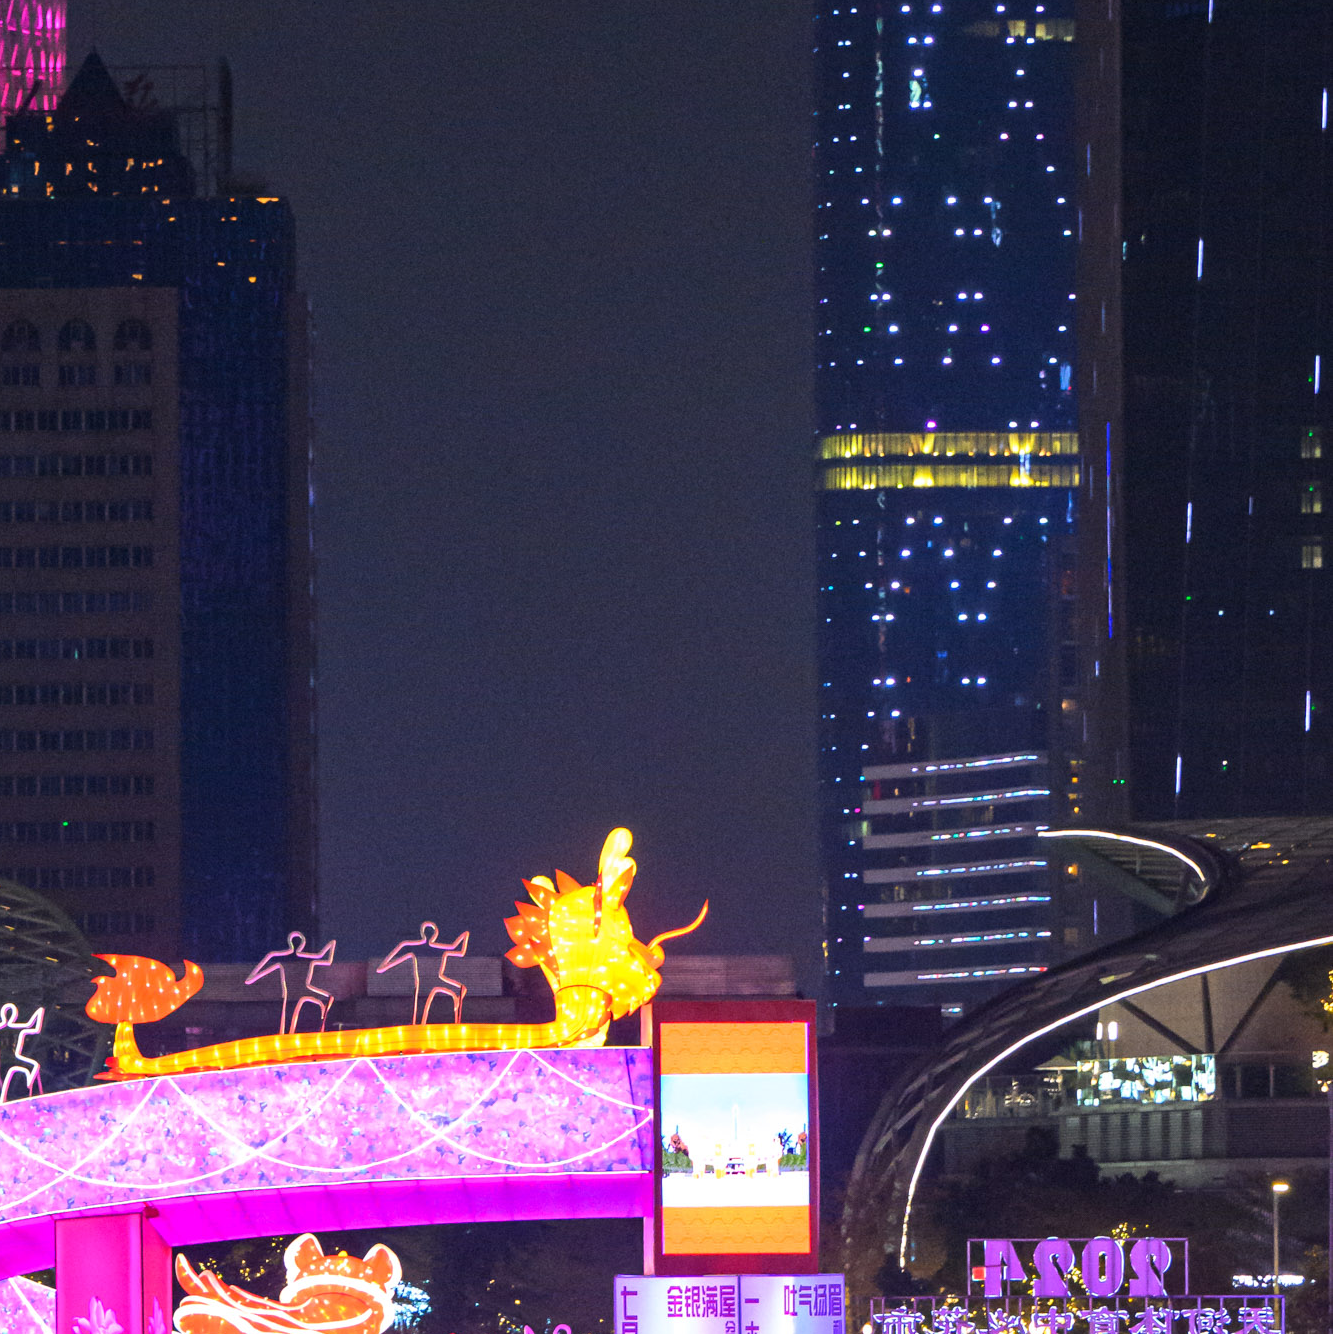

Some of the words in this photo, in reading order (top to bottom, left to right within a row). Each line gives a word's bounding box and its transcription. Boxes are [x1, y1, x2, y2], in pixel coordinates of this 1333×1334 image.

[667, 1285, 736, 1318] 金银满屋
[783, 1283, 842, 1317] 吐气扬眉
